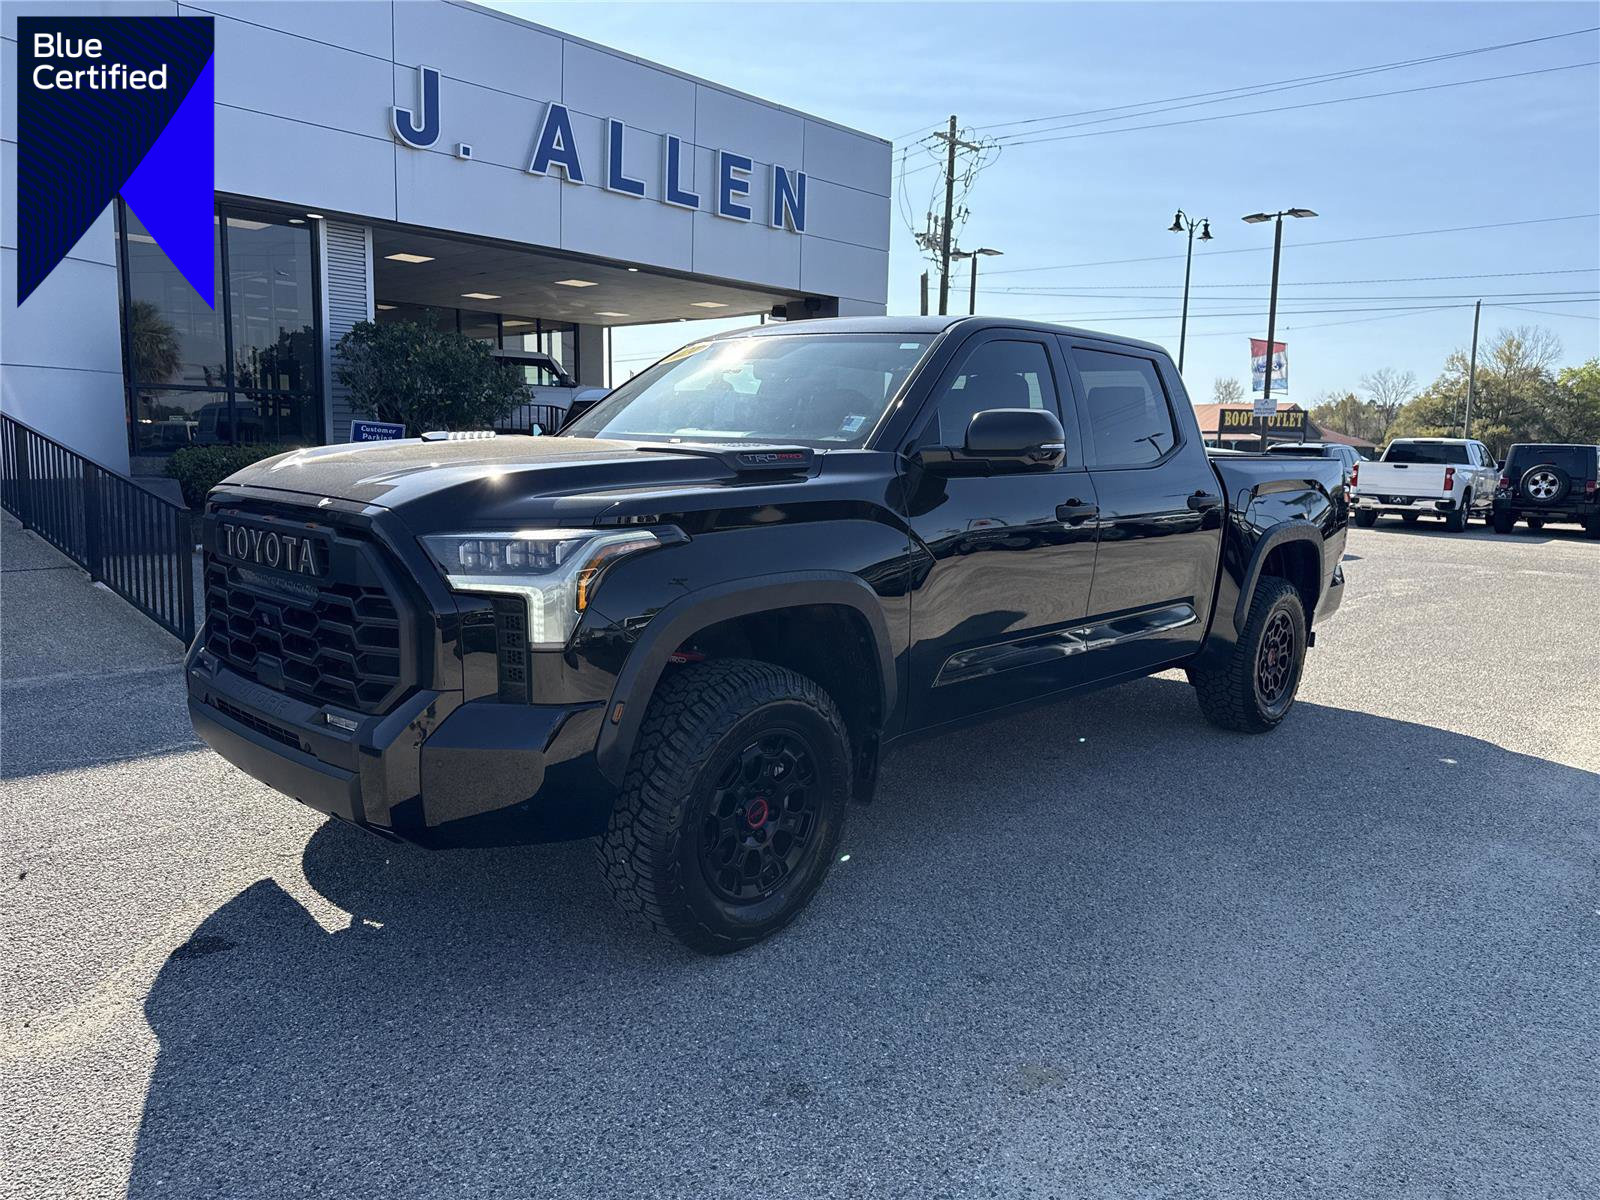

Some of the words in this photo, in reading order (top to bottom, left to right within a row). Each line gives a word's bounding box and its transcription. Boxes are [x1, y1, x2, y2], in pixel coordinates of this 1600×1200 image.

[391, 64, 473, 159] J.
[526, 101, 808, 234] ALLEN
[360, 425, 397, 434] Customer
[1223, 410, 1255, 427] BOOT
[1260, 411, 1304, 428] UTLET
[223, 523, 316, 576] TOYOTA
